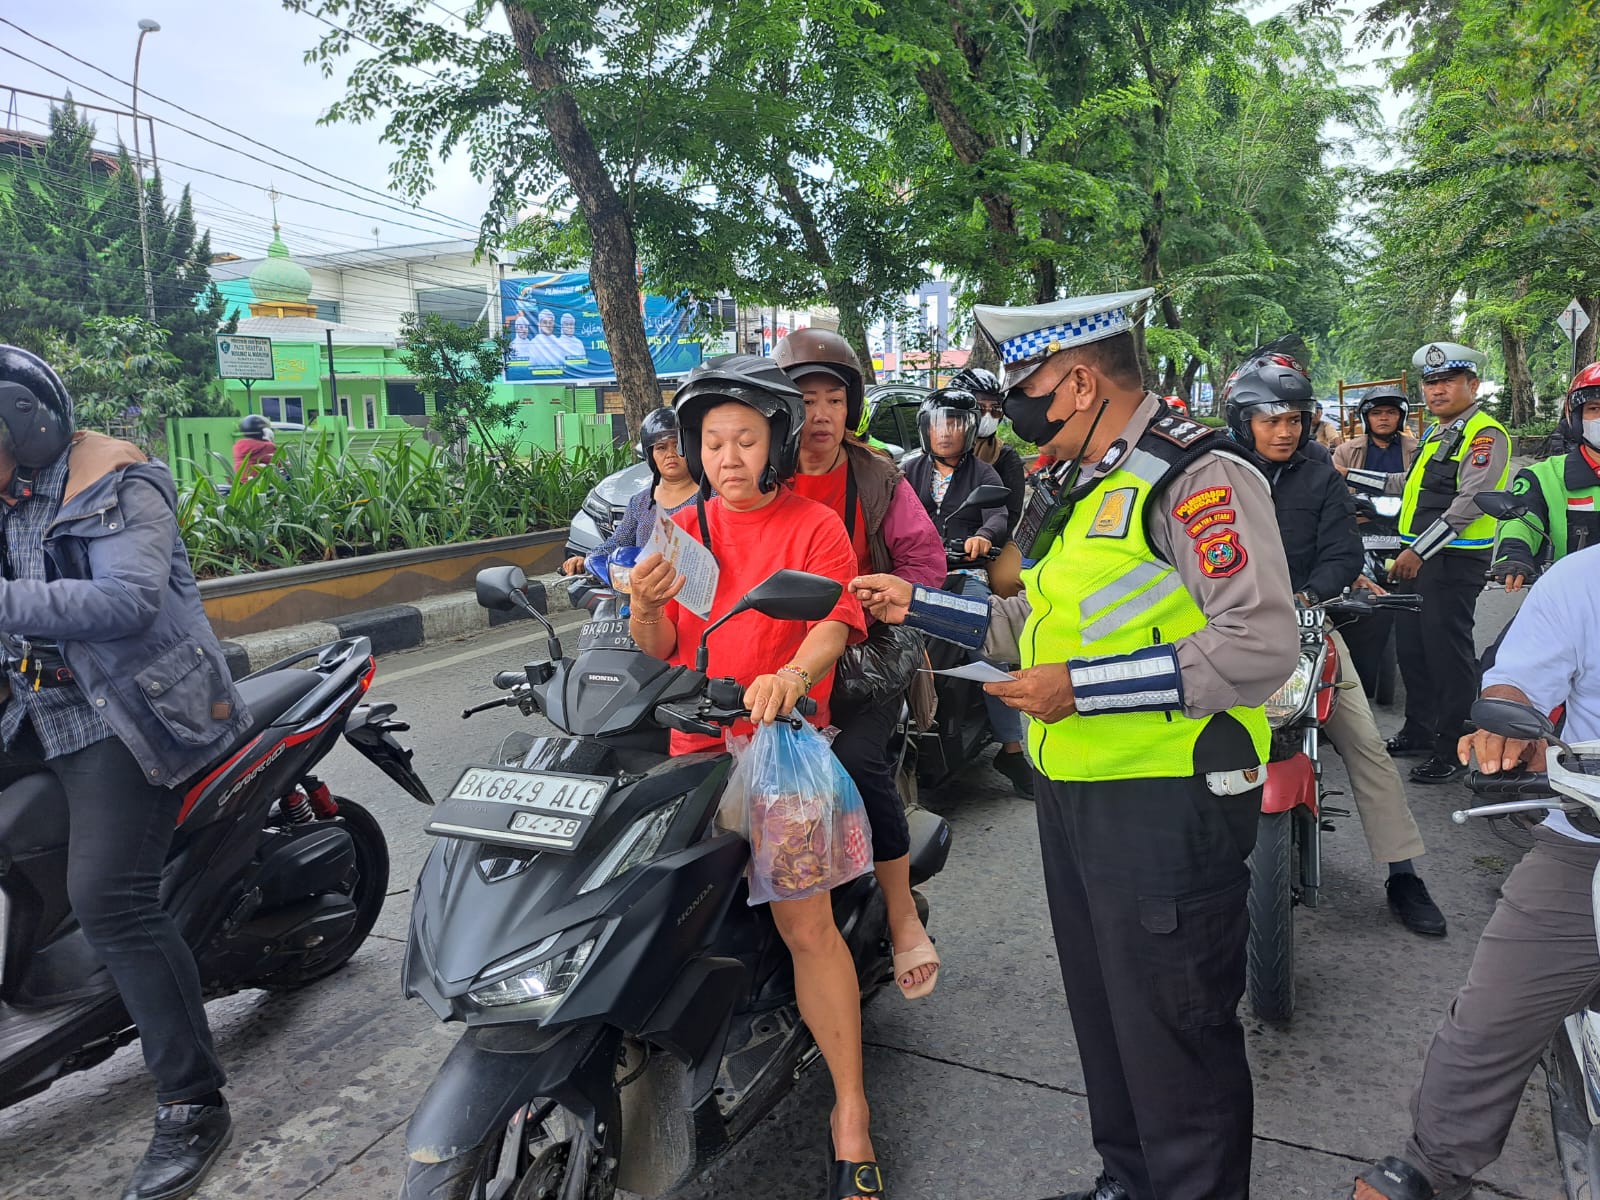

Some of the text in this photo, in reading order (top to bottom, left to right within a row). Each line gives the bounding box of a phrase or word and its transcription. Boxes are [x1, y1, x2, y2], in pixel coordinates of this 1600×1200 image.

[589, 674, 620, 682] HONDA
[549, 784, 598, 810] ALC
[677, 883, 714, 926] HONDA
